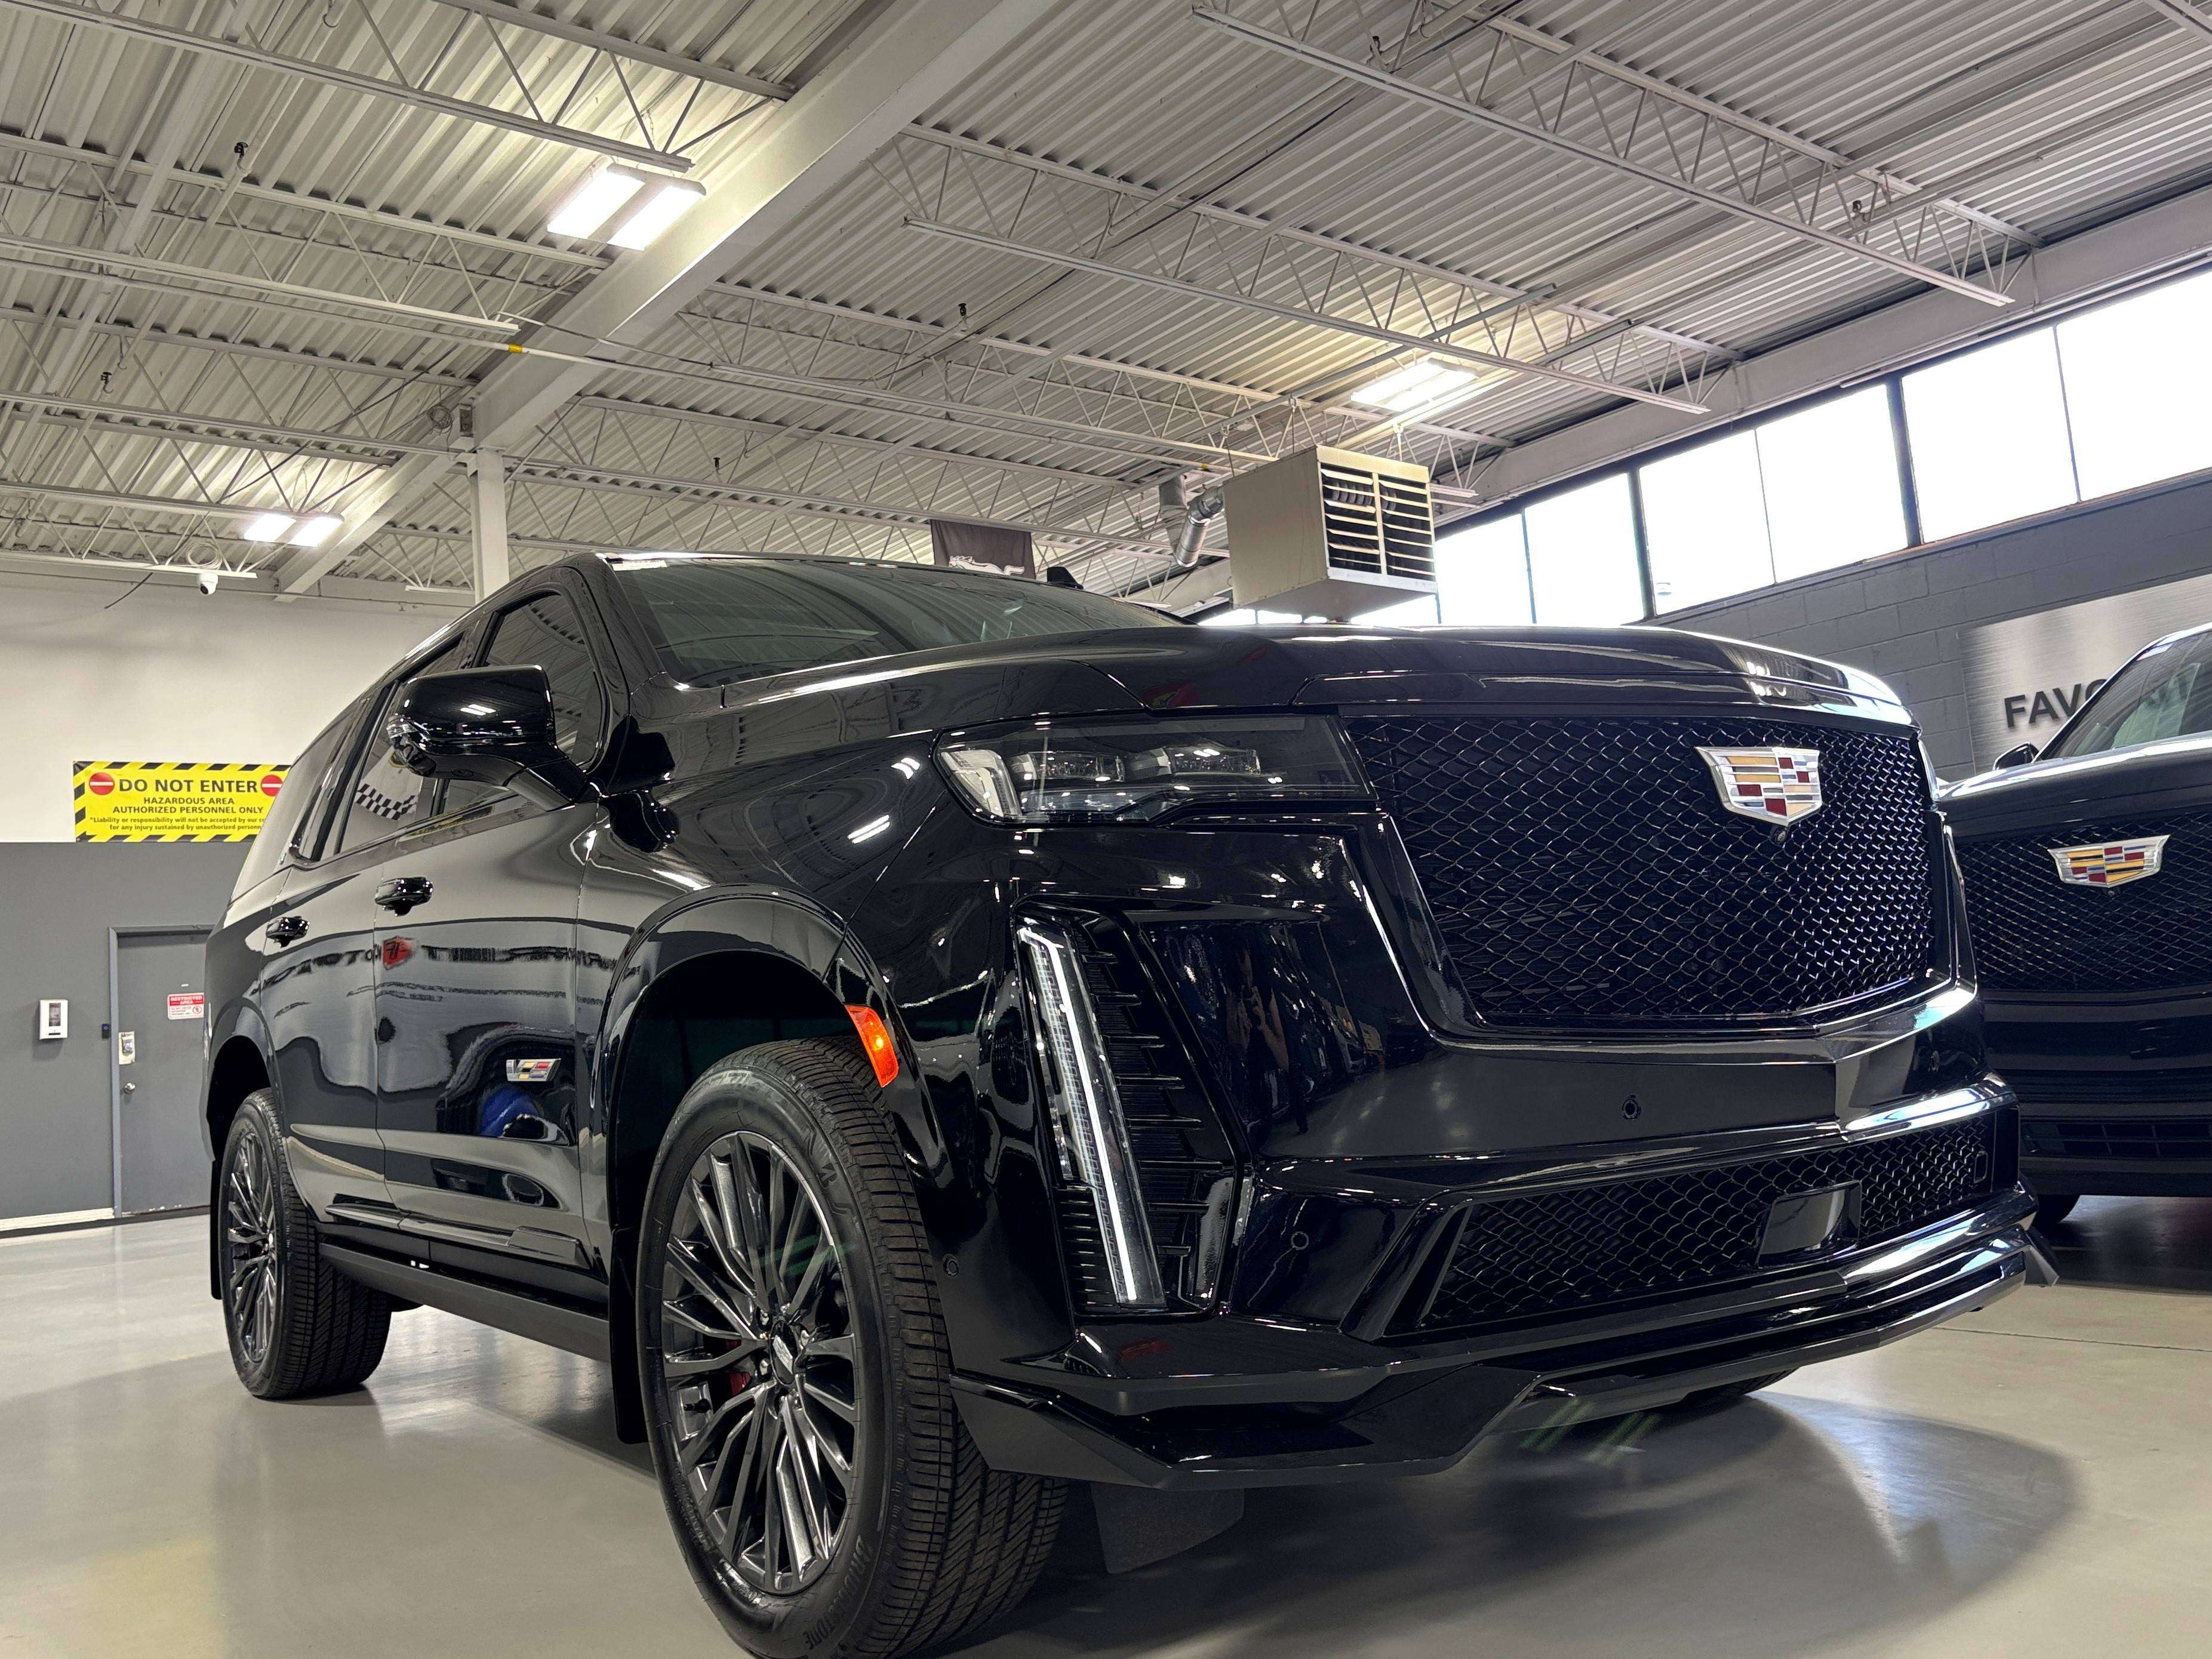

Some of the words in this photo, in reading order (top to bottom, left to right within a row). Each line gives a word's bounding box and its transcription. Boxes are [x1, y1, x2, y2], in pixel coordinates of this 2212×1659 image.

[119, 779, 147, 792] DO
[155, 780, 193, 792] NOT
[201, 780, 257, 793] ENTER
